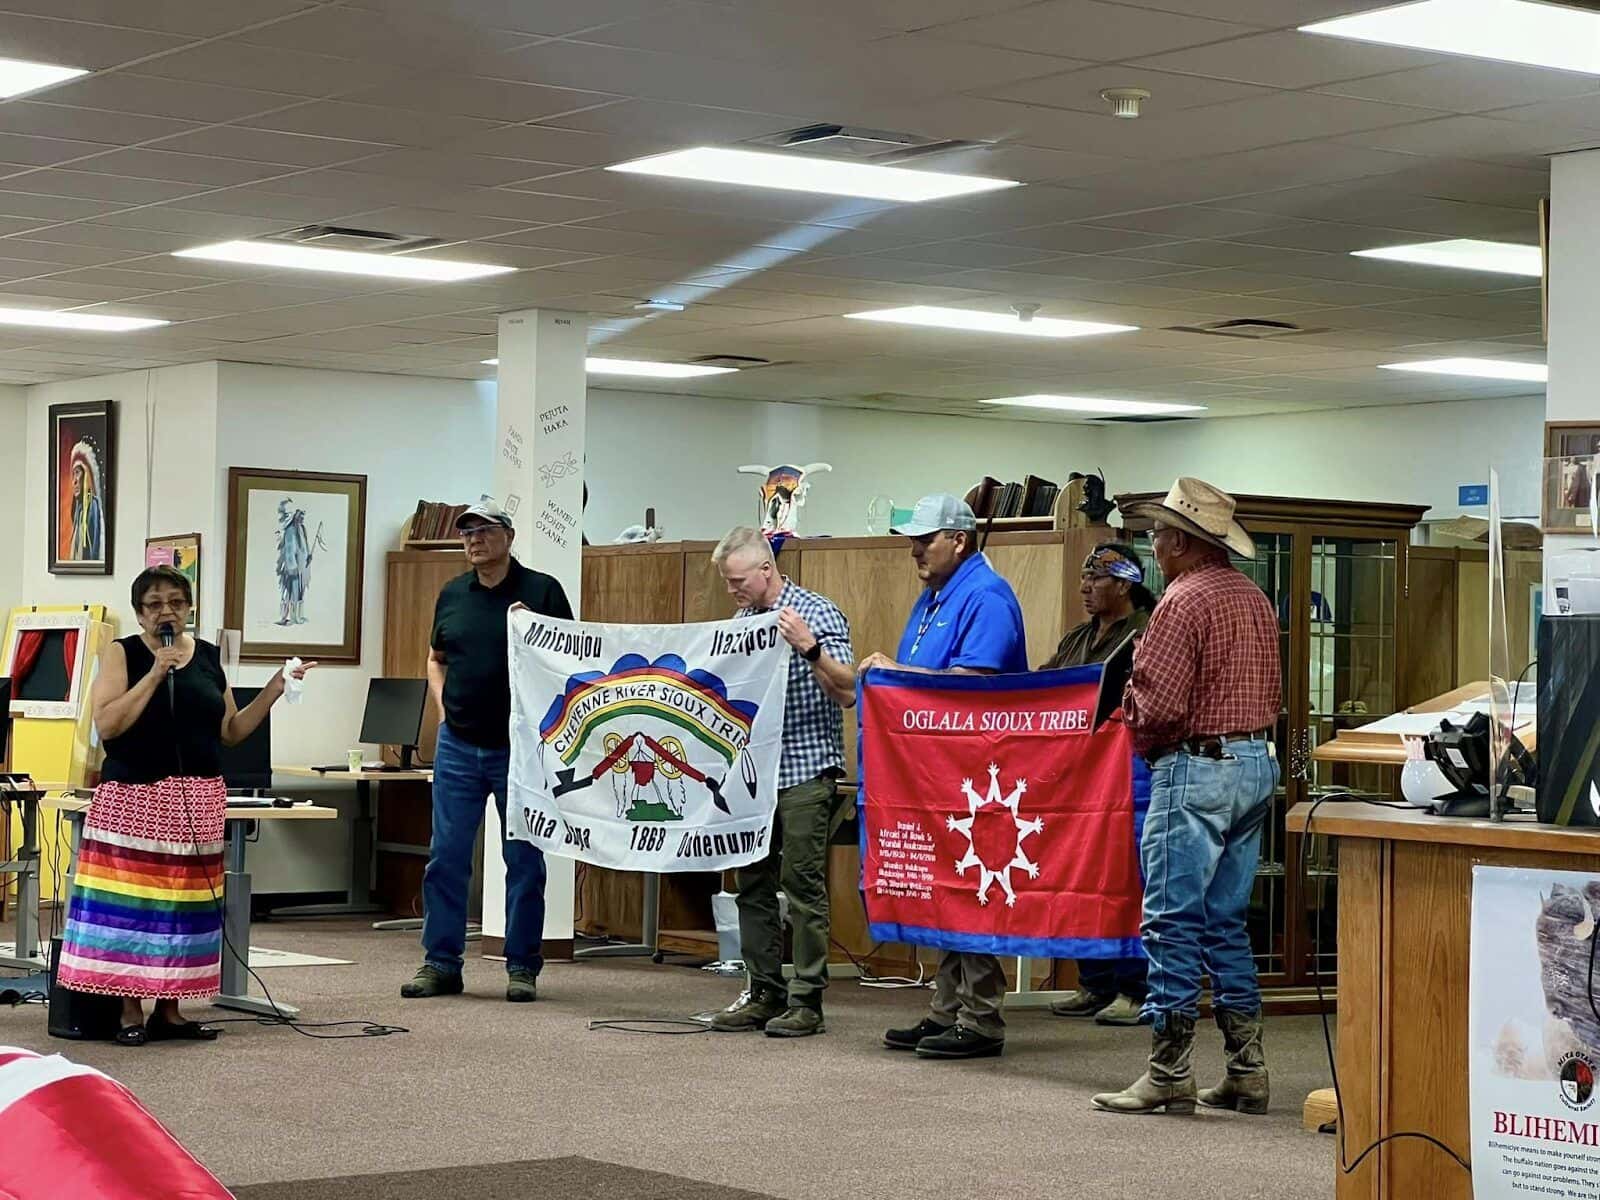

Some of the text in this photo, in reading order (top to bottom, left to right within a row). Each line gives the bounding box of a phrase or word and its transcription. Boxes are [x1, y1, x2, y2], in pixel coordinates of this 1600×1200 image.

[540, 405, 569, 422] PEJUTA
[544, 420, 569, 435] HAKA
[554, 684, 746, 753] CHEYENNE RIVER SIOUX TRIB
[903, 710, 1089, 731] OGLALA SIOUX TRIBE
[630, 825, 667, 852] 1868
[1493, 1111, 1600, 1147] BLIHEMI
